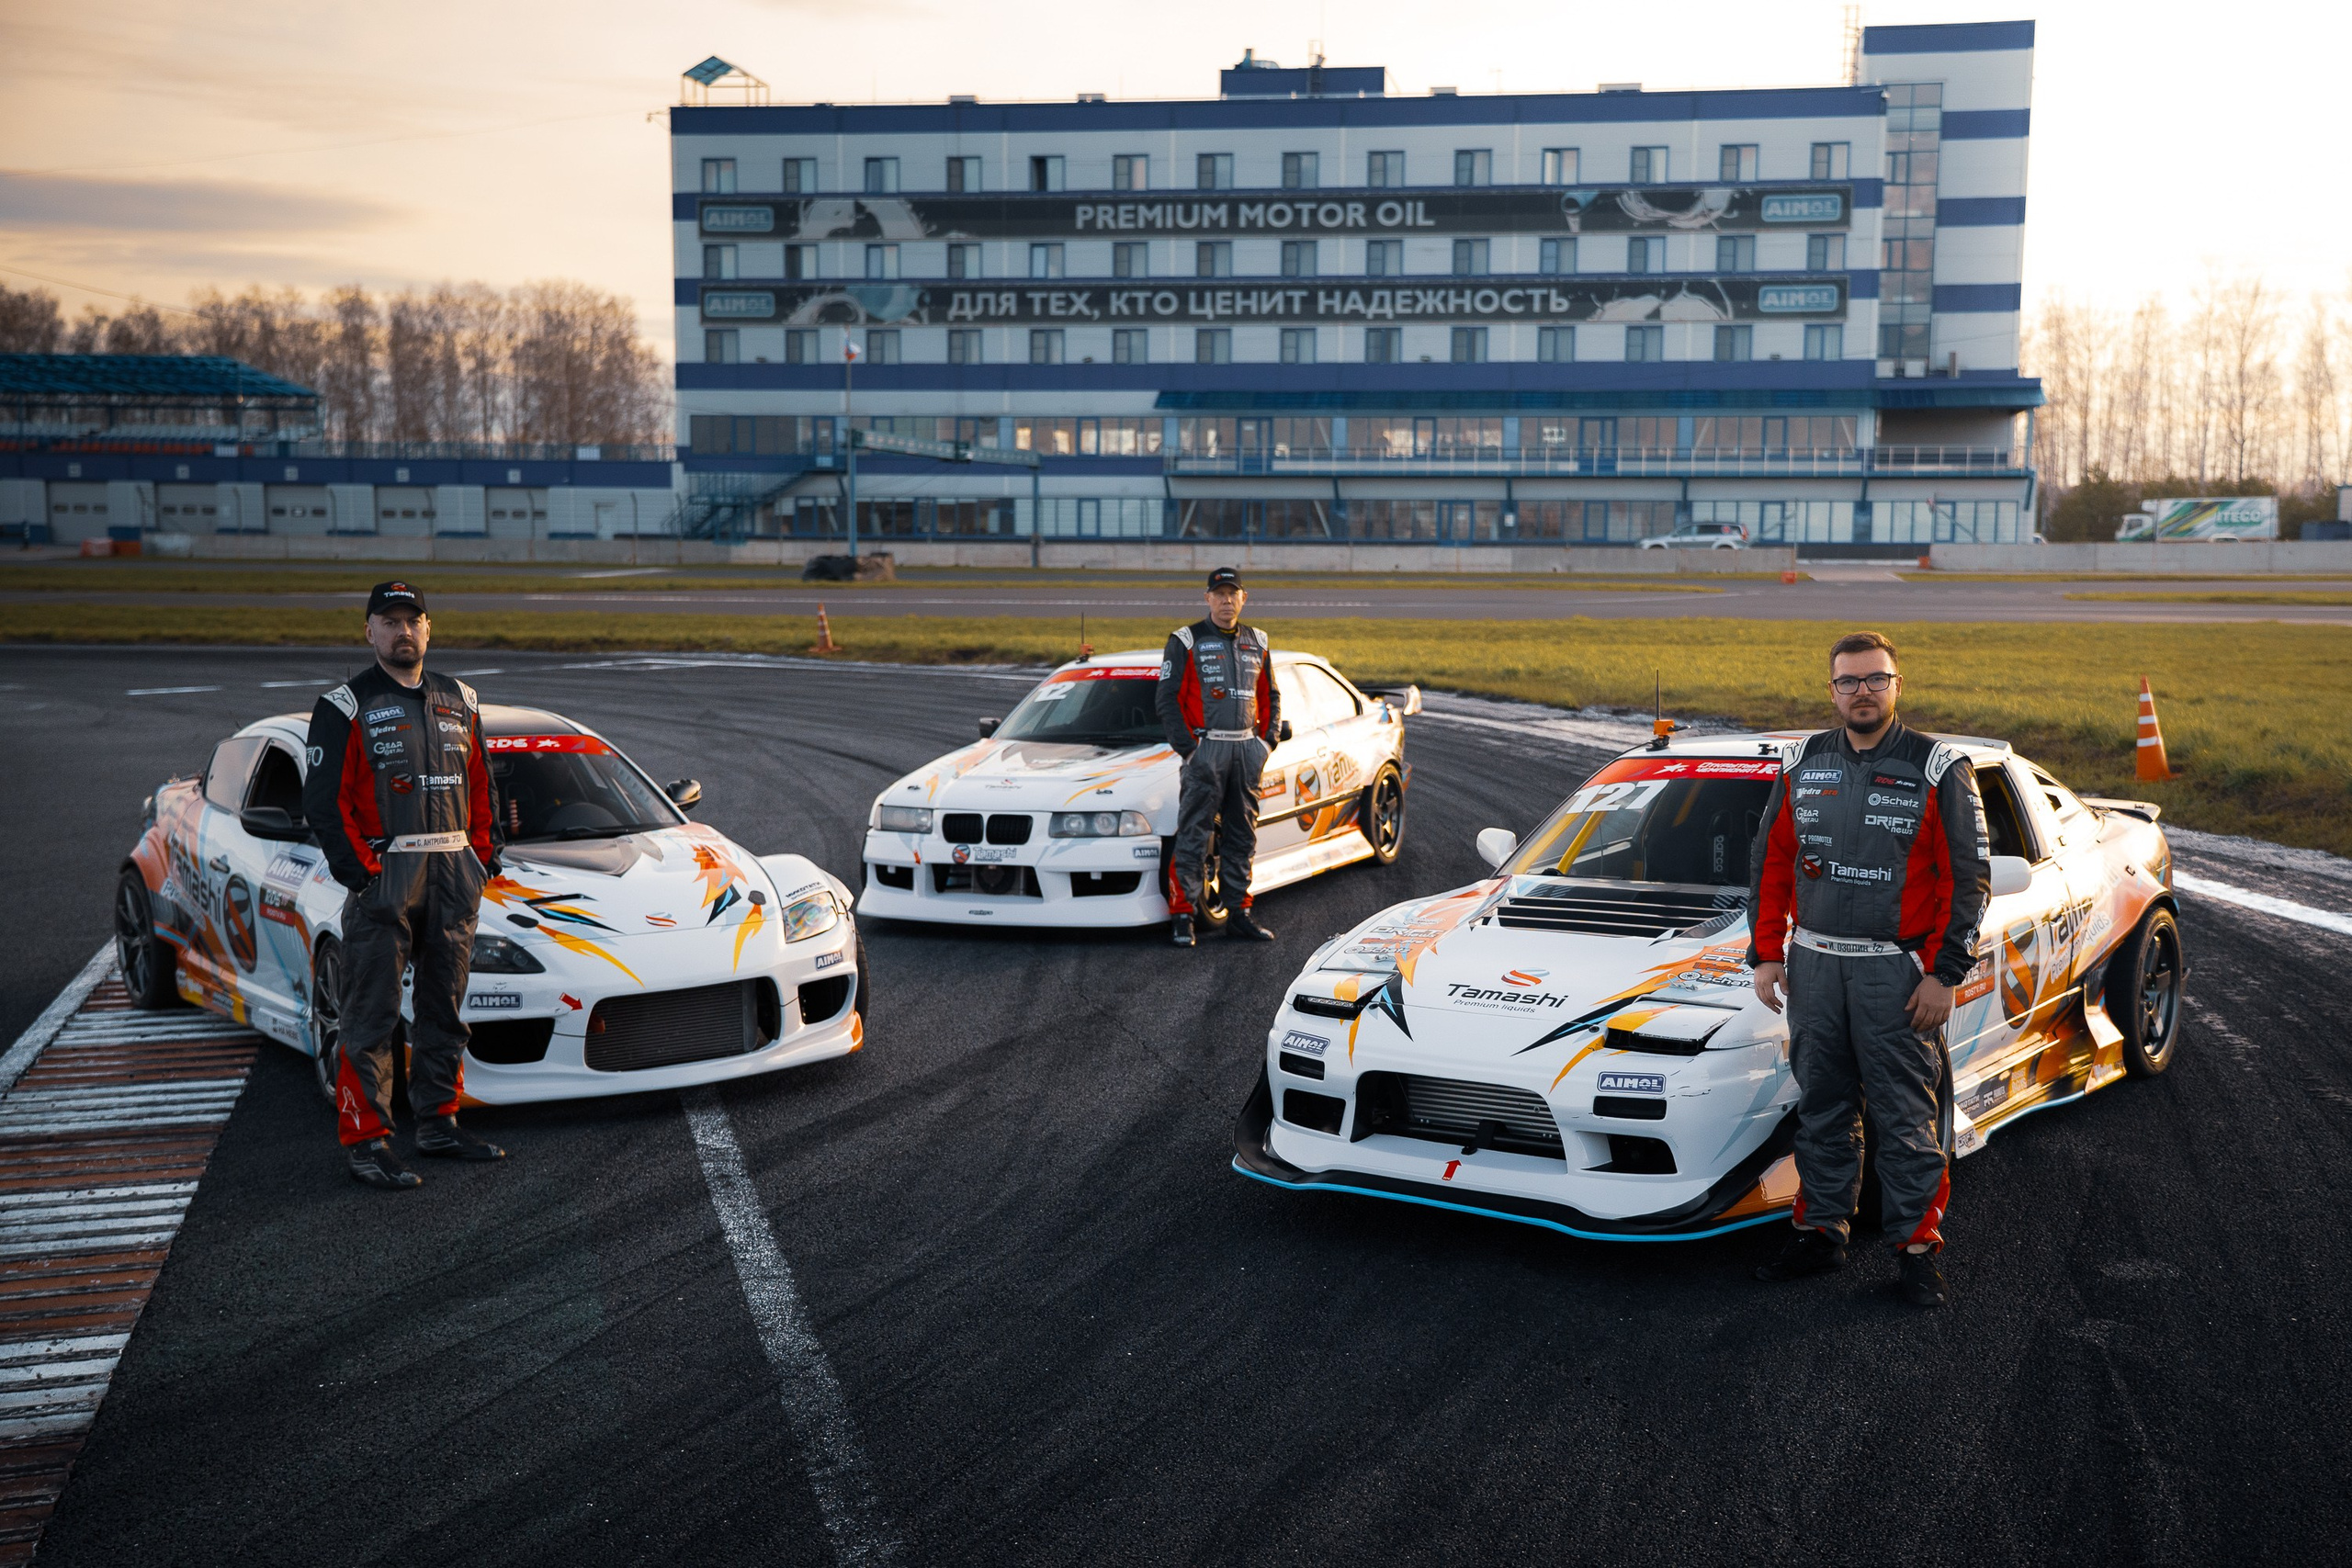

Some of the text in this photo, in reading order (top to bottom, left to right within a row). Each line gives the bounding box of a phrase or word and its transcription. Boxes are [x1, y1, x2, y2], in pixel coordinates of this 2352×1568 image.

[1075, 201, 1436, 230] PREMIUM MOTOR OIL
[1766, 199, 1837, 217] AIMOL
[707, 209, 769, 228] AIMOL
[708, 296, 770, 313] AIMOL
[947, 288, 1570, 320] ДЛЯ ТЕХ, КТО ЦЕНИТ НАДЕЖНОСТЬ
[1763, 290, 1832, 309] AIMOL
[2216, 511, 2261, 524] ITECO
[1034, 681, 1076, 703] 12
[368, 709, 401, 722] AIMOL
[485, 739, 528, 749] RDS
[418, 773, 463, 786] Tamashi
[1802, 772, 1838, 781] AIMOL
[1566, 779, 1670, 815] 127
[1881, 795, 1919, 808] Schatz
[1890, 827, 1914, 835] news
[972, 847, 1017, 859] Tamashi
[267, 856, 309, 881] AIMOL
[1828, 861, 1892, 882] Tamashi
[817, 952, 843, 969] AIMOL
[1697, 974, 1755, 988] Schatz
[470, 996, 519, 1007] AIMOL
[1447, 983, 1569, 1009] Tamashi
[1453, 998, 1536, 1014] Premium liquids
[1283, 1035, 1324, 1051] AIMOL
[1600, 1077, 1662, 1090] AIMOL
